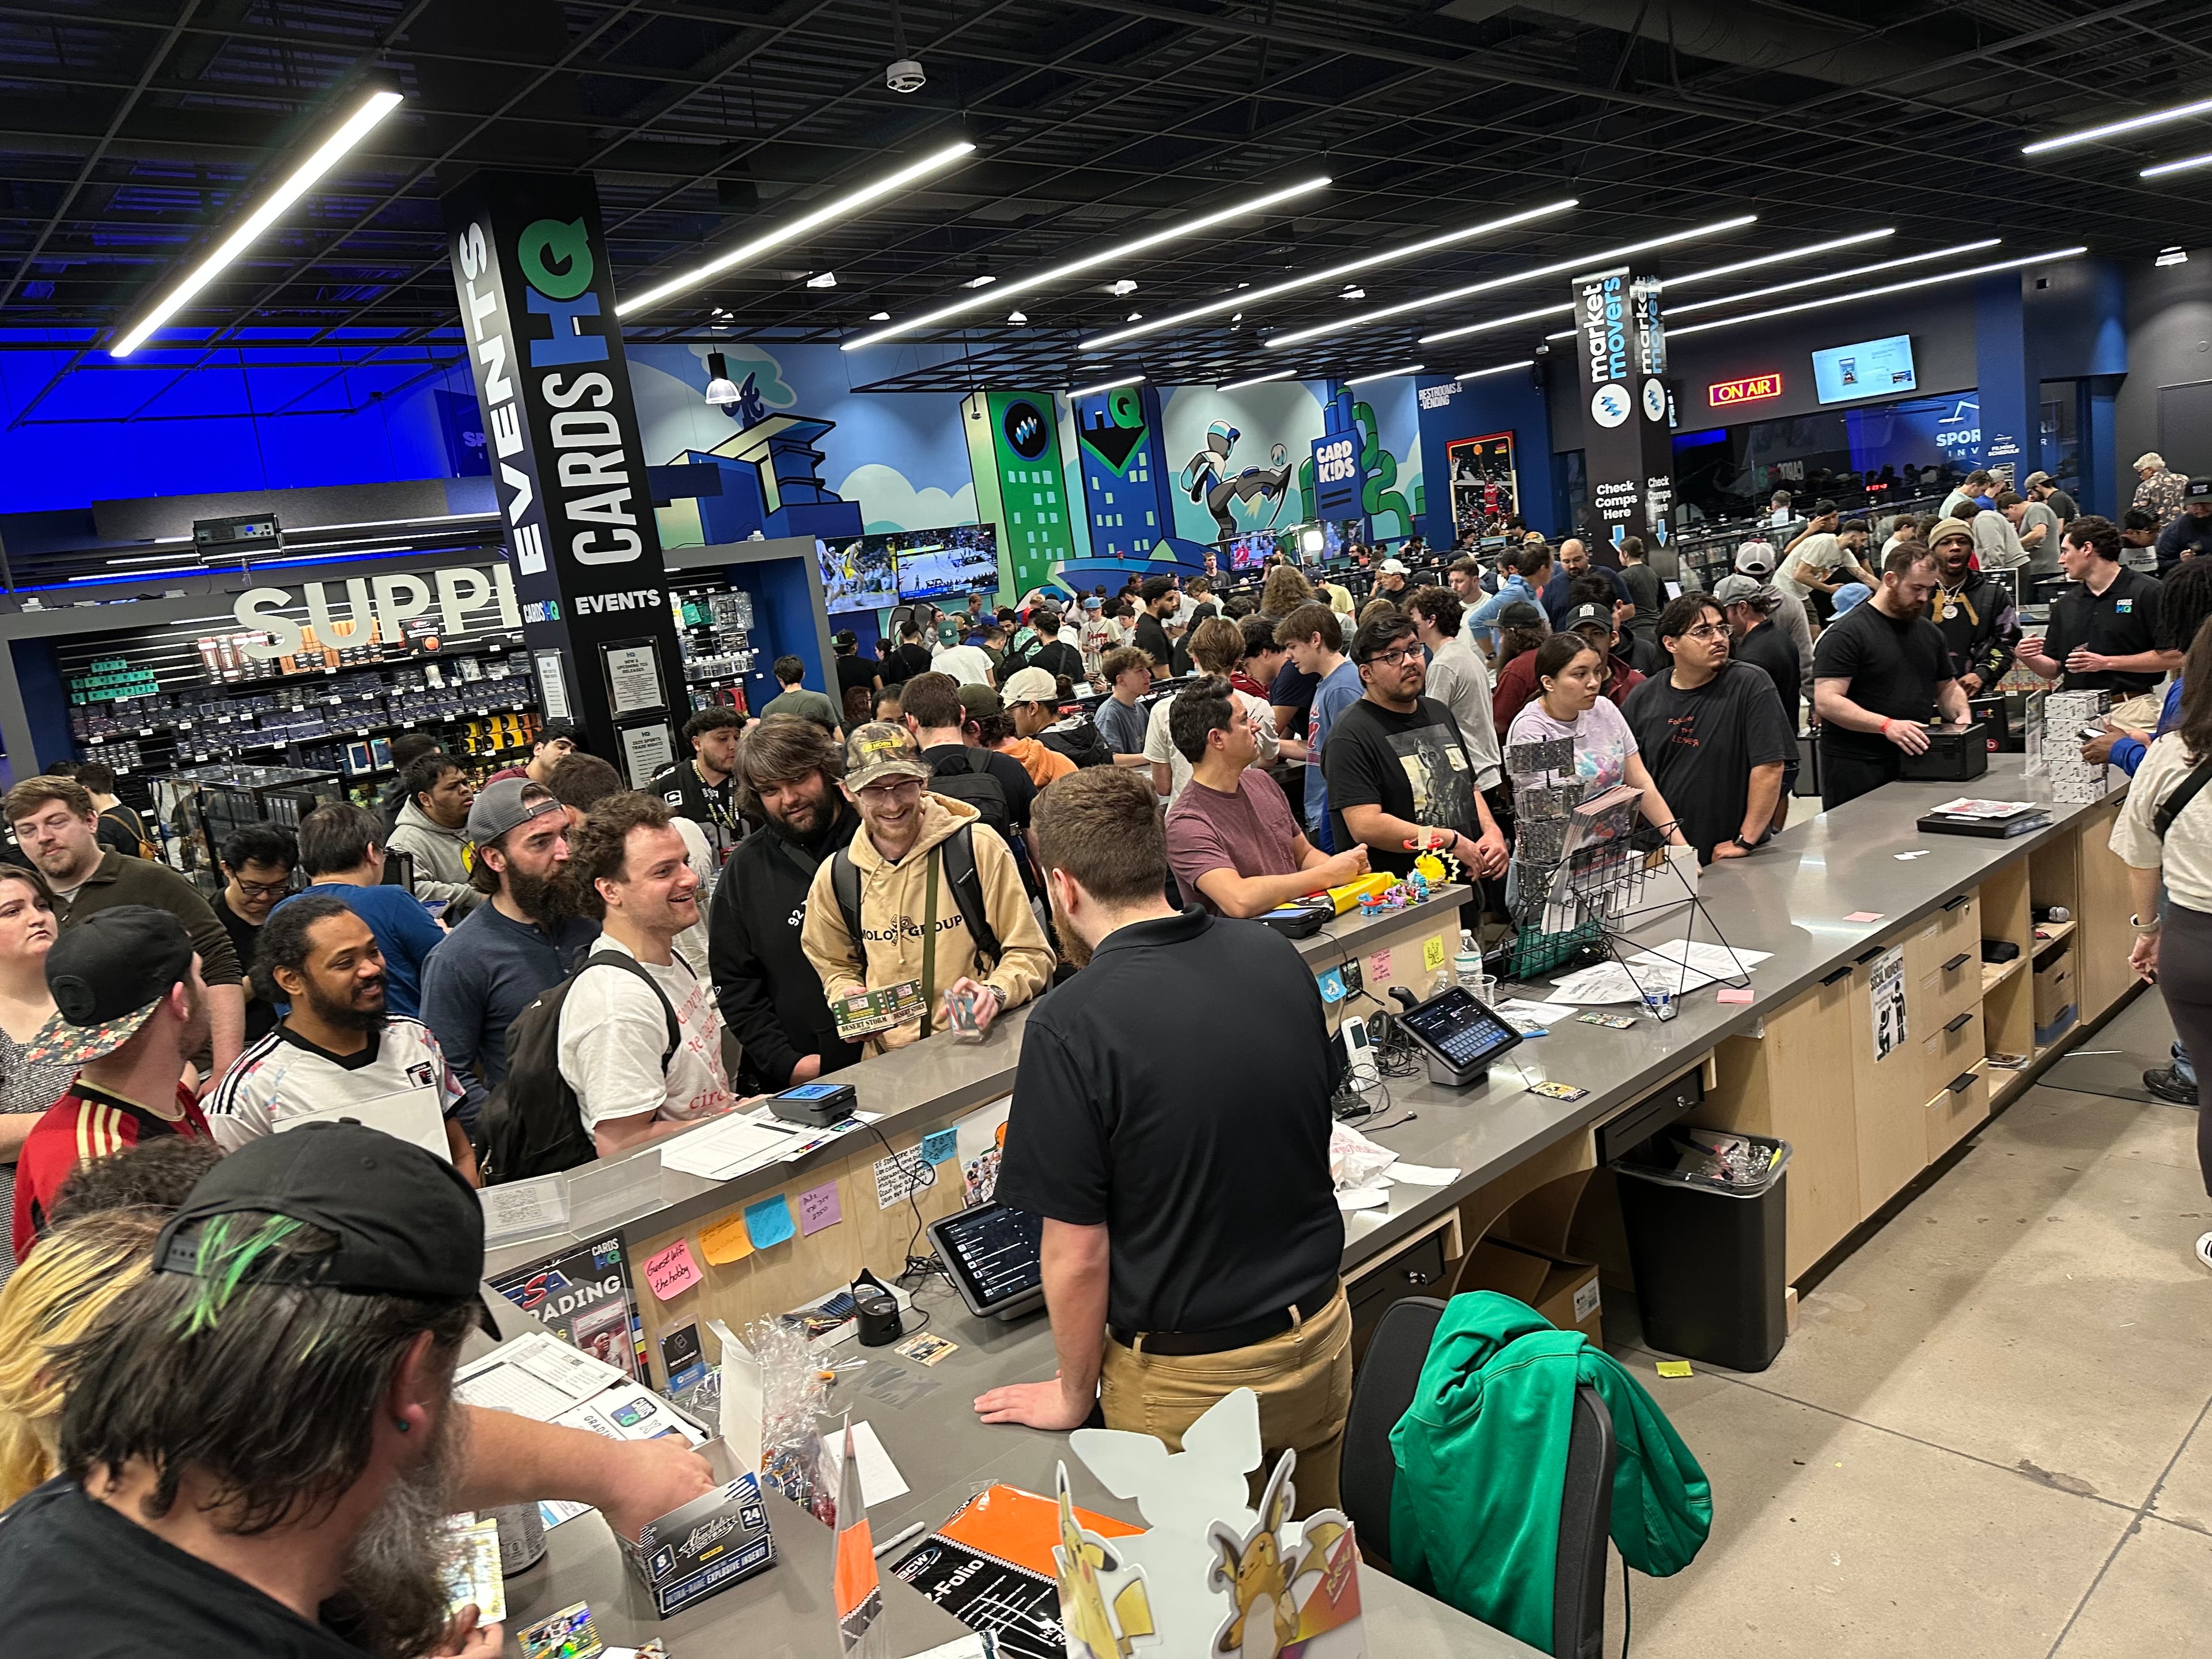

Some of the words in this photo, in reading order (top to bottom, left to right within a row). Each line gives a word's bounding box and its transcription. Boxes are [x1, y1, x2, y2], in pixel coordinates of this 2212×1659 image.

[1583, 283, 1609, 384] market
[1604, 276, 1627, 380] movers
[460, 222, 547, 575] EVENTS
[1418, 382, 1456, 401] RESTROOMS
[1456, 381, 1463, 393] &
[1718, 385, 1744, 402] ON
[1745, 378, 1772, 398] AIR
[1422, 395, 1450, 410] VENDING
[1316, 440, 1353, 464] CARD
[1987, 448, 2020, 457] SCHEDULE
[1596, 480, 1635, 495] Check
[1647, 475, 1669, 488] Check
[1595, 493, 1638, 510] Comps
[1647, 488, 1672, 502] Comps
[1603, 507, 1631, 521] Here
[1652, 501, 1669, 514] Here
[575, 589, 661, 615] EVENTS
[788, 910, 804, 926] 92
[893, 1008, 910, 1020] DESERT
[842, 1021, 865, 1032] DESERT
[865, 1016, 888, 1027] STORM
[592, 1238, 619, 1256] CARDS
[593, 1249, 621, 1271] HQ
[646, 1251, 671, 1277] Guest
[742, 1507, 761, 1522] 24
[691, 1521, 735, 1554] FOOTBALL
[706, 1560, 741, 1585] EXPLOSIVE
[896, 1553, 929, 1581] BCW
